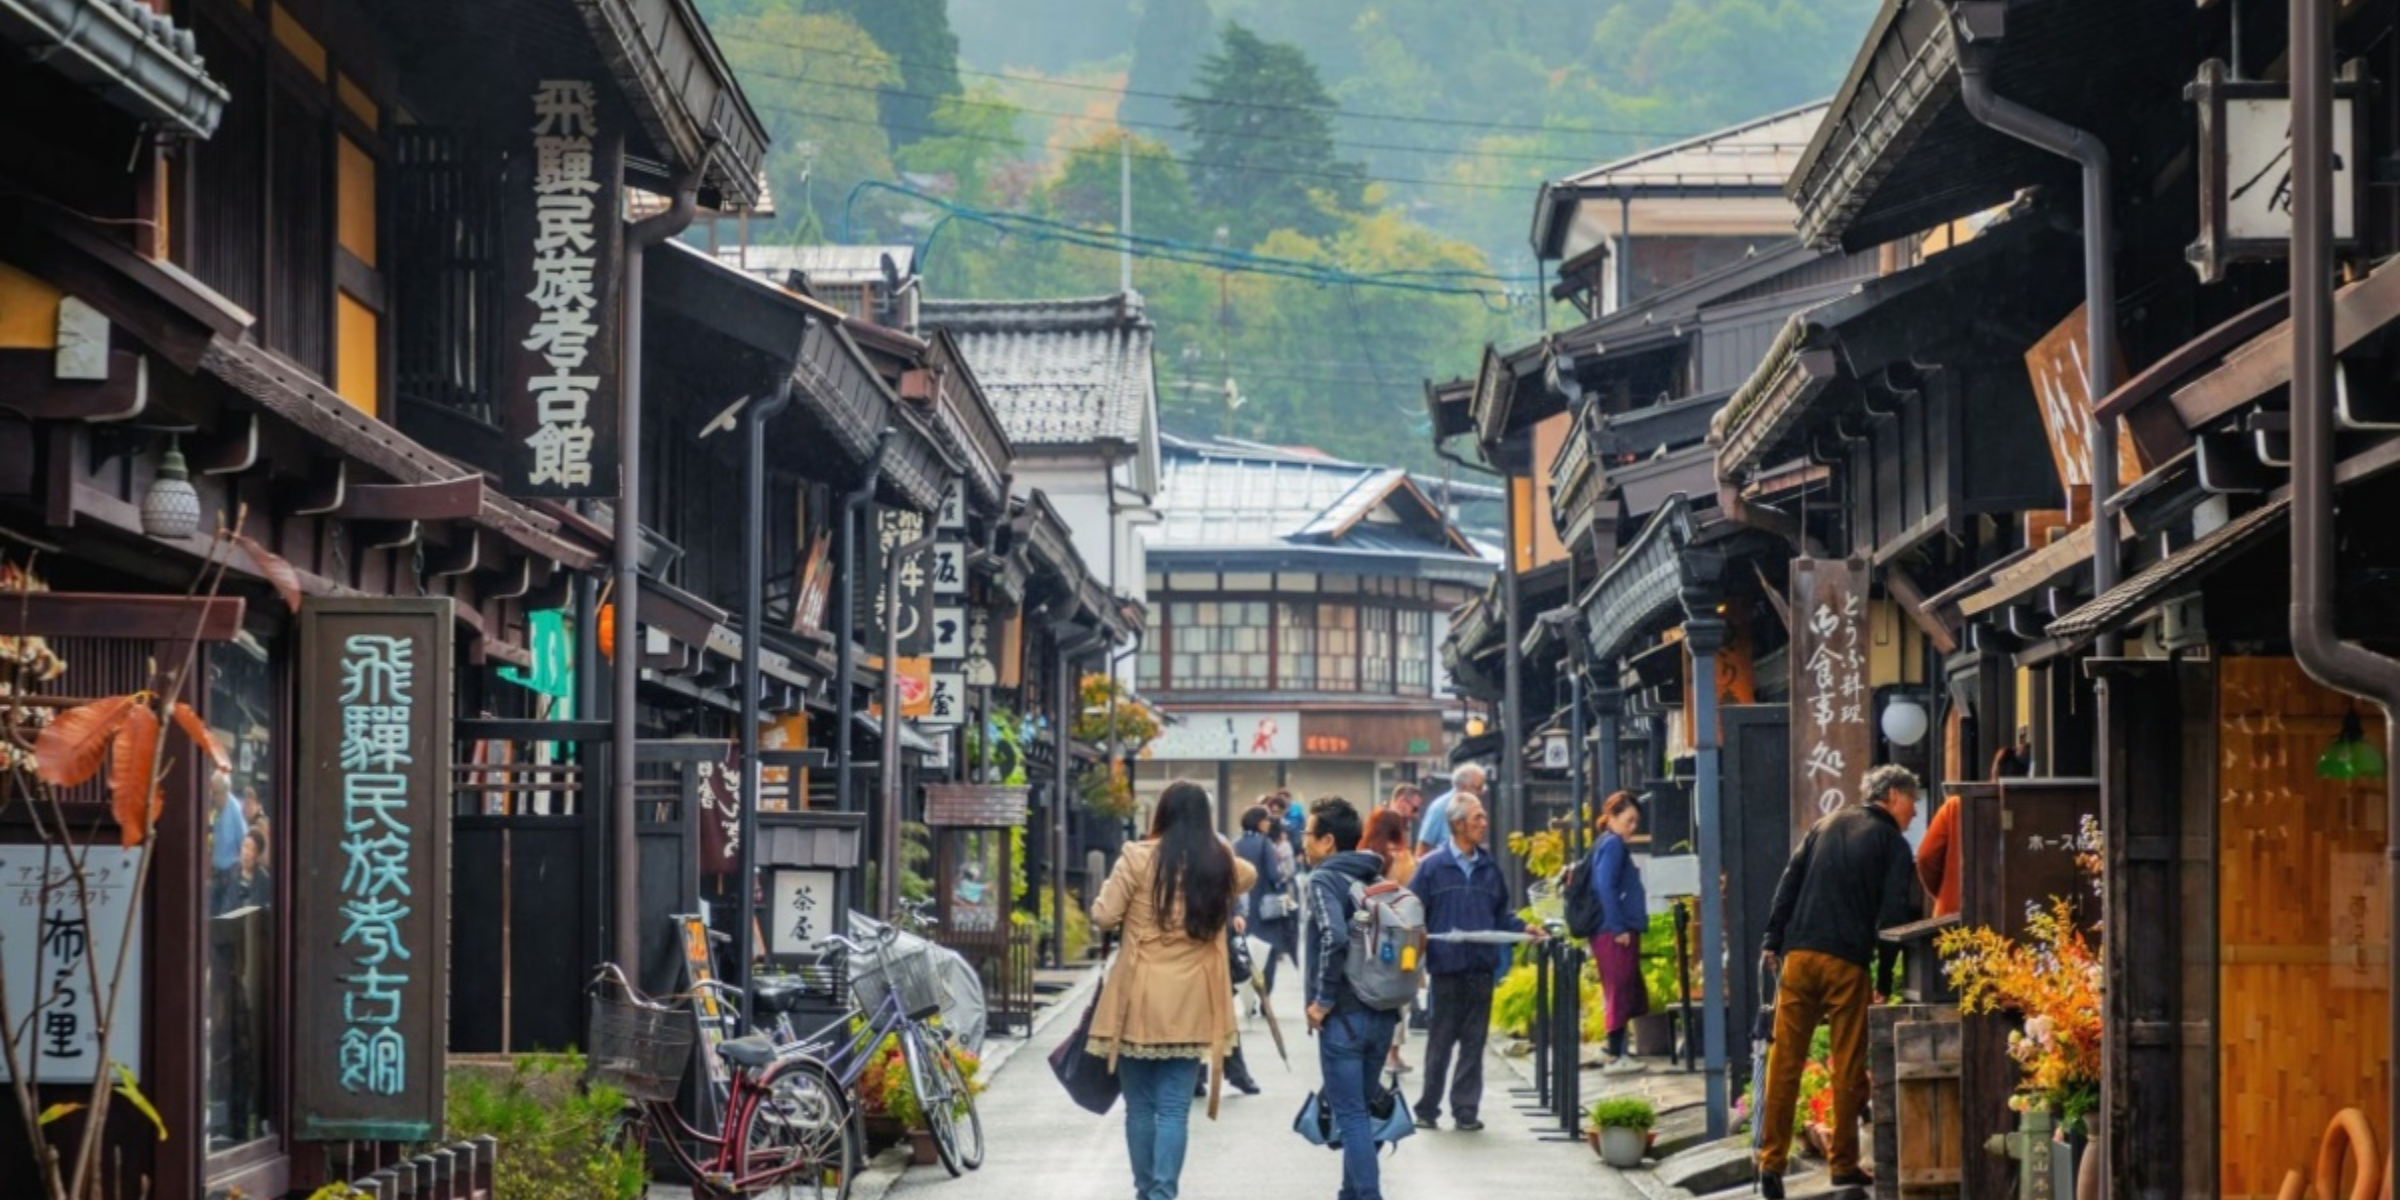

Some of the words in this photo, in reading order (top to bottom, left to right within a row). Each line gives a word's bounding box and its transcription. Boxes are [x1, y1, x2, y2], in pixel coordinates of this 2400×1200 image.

[1840, 592, 1865, 722] とうふ料理
[19, 867, 110, 882] アンテーク
[19, 888, 110, 906] 古クラフト
[790, 885, 816, 941] 茶屋
